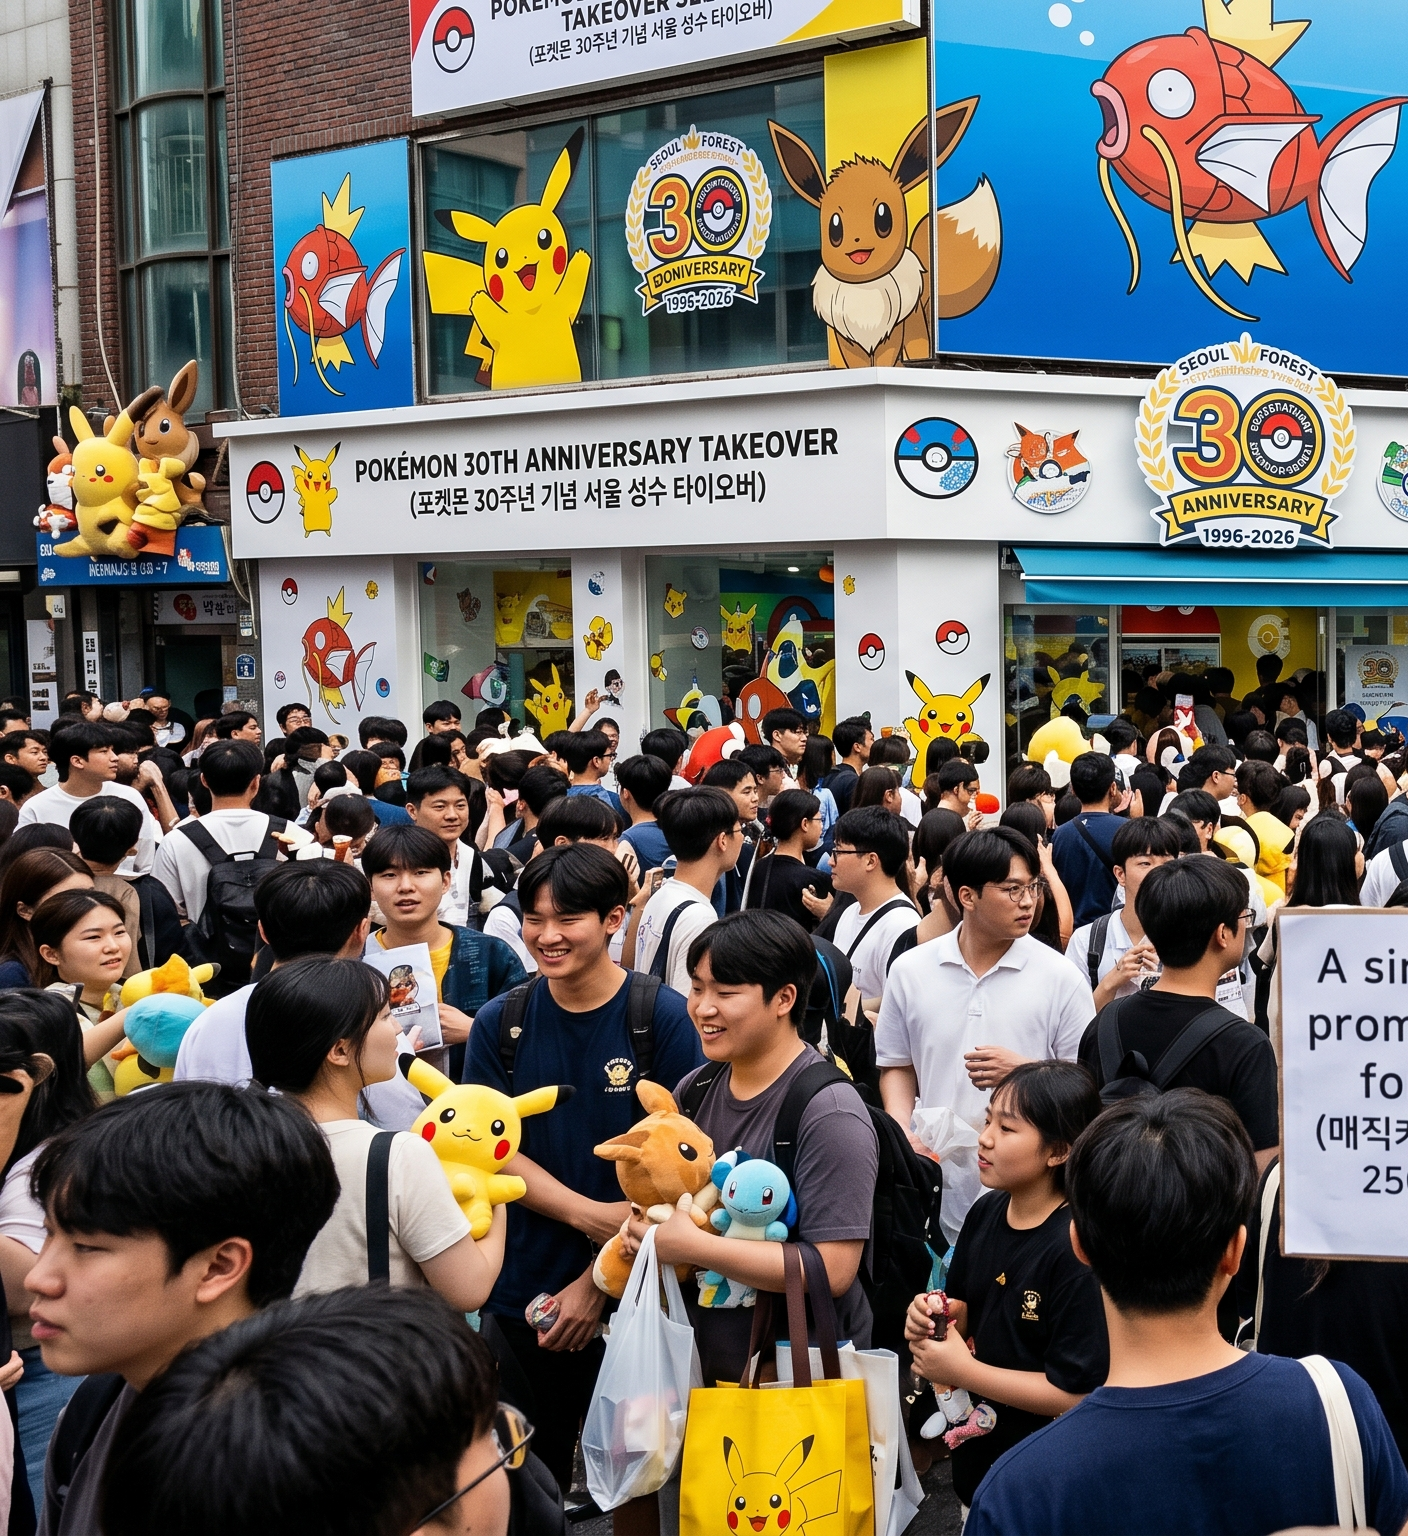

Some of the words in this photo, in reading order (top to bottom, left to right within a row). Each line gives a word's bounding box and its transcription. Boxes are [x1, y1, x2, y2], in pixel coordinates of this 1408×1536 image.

[529, 39, 571, 66] (포켓몬
[575, 31, 617, 55] 30주년
[622, 23, 647, 46] 기념
[651, 17, 677, 40] 서울
[681, 12, 708, 35] 성수
[712, 0, 773, 27] 타이오버)
[650, 142, 682, 171] SEOUL
[702, 135, 743, 156] FOREST
[647, 166, 750, 262] 30
[1179, 348, 1229, 376] SEOUL
[1260, 349, 1318, 382] FOREST
[355, 450, 458, 482] POKÉMON
[463, 449, 518, 477] 30TH
[525, 437, 692, 473] ANNIVERSARY
[699, 427, 838, 462] TAKEOVER
[1173, 385, 1326, 486] 30
[410, 487, 469, 519] (포켓몬
[474, 482, 535, 514] 30주년
[541, 480, 577, 512] 기념
[583, 477, 622, 510] 서울
[628, 476, 667, 508] 성수
[673, 470, 767, 504] 타이오버)
[1182, 493, 1315, 517] ANNIVERSARY
[1203, 528, 1295, 545] 1996-2026
[1317, 948, 1347, 984] A
